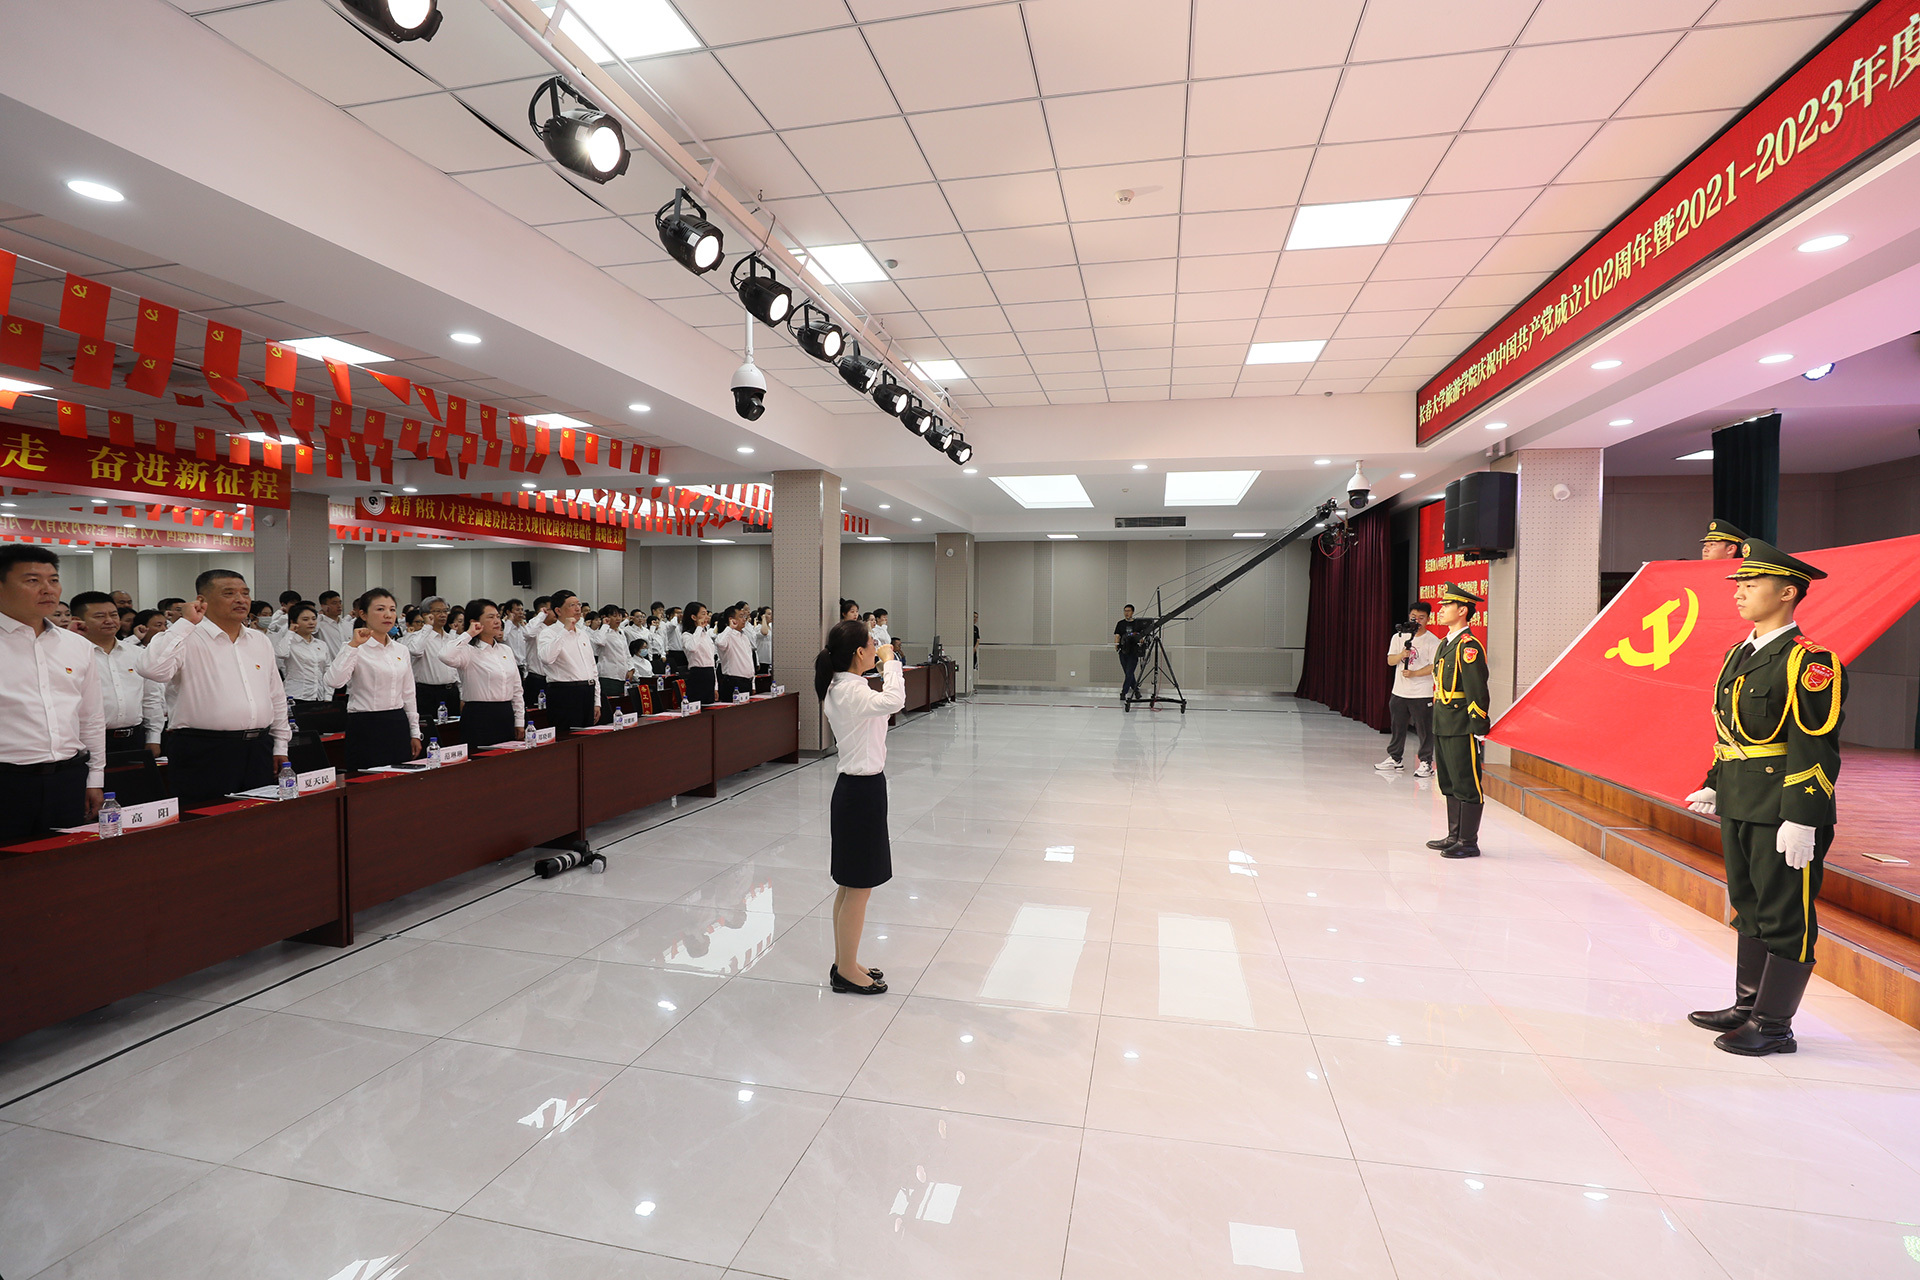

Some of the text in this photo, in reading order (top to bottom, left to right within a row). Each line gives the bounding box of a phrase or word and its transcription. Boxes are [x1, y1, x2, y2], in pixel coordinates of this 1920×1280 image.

[1, 432, 280, 500] 走 奋进新征程
[390, 495, 411, 517] 教育
[415, 498, 436, 519] 科技
[304, 775, 329, 788] 夏天民
